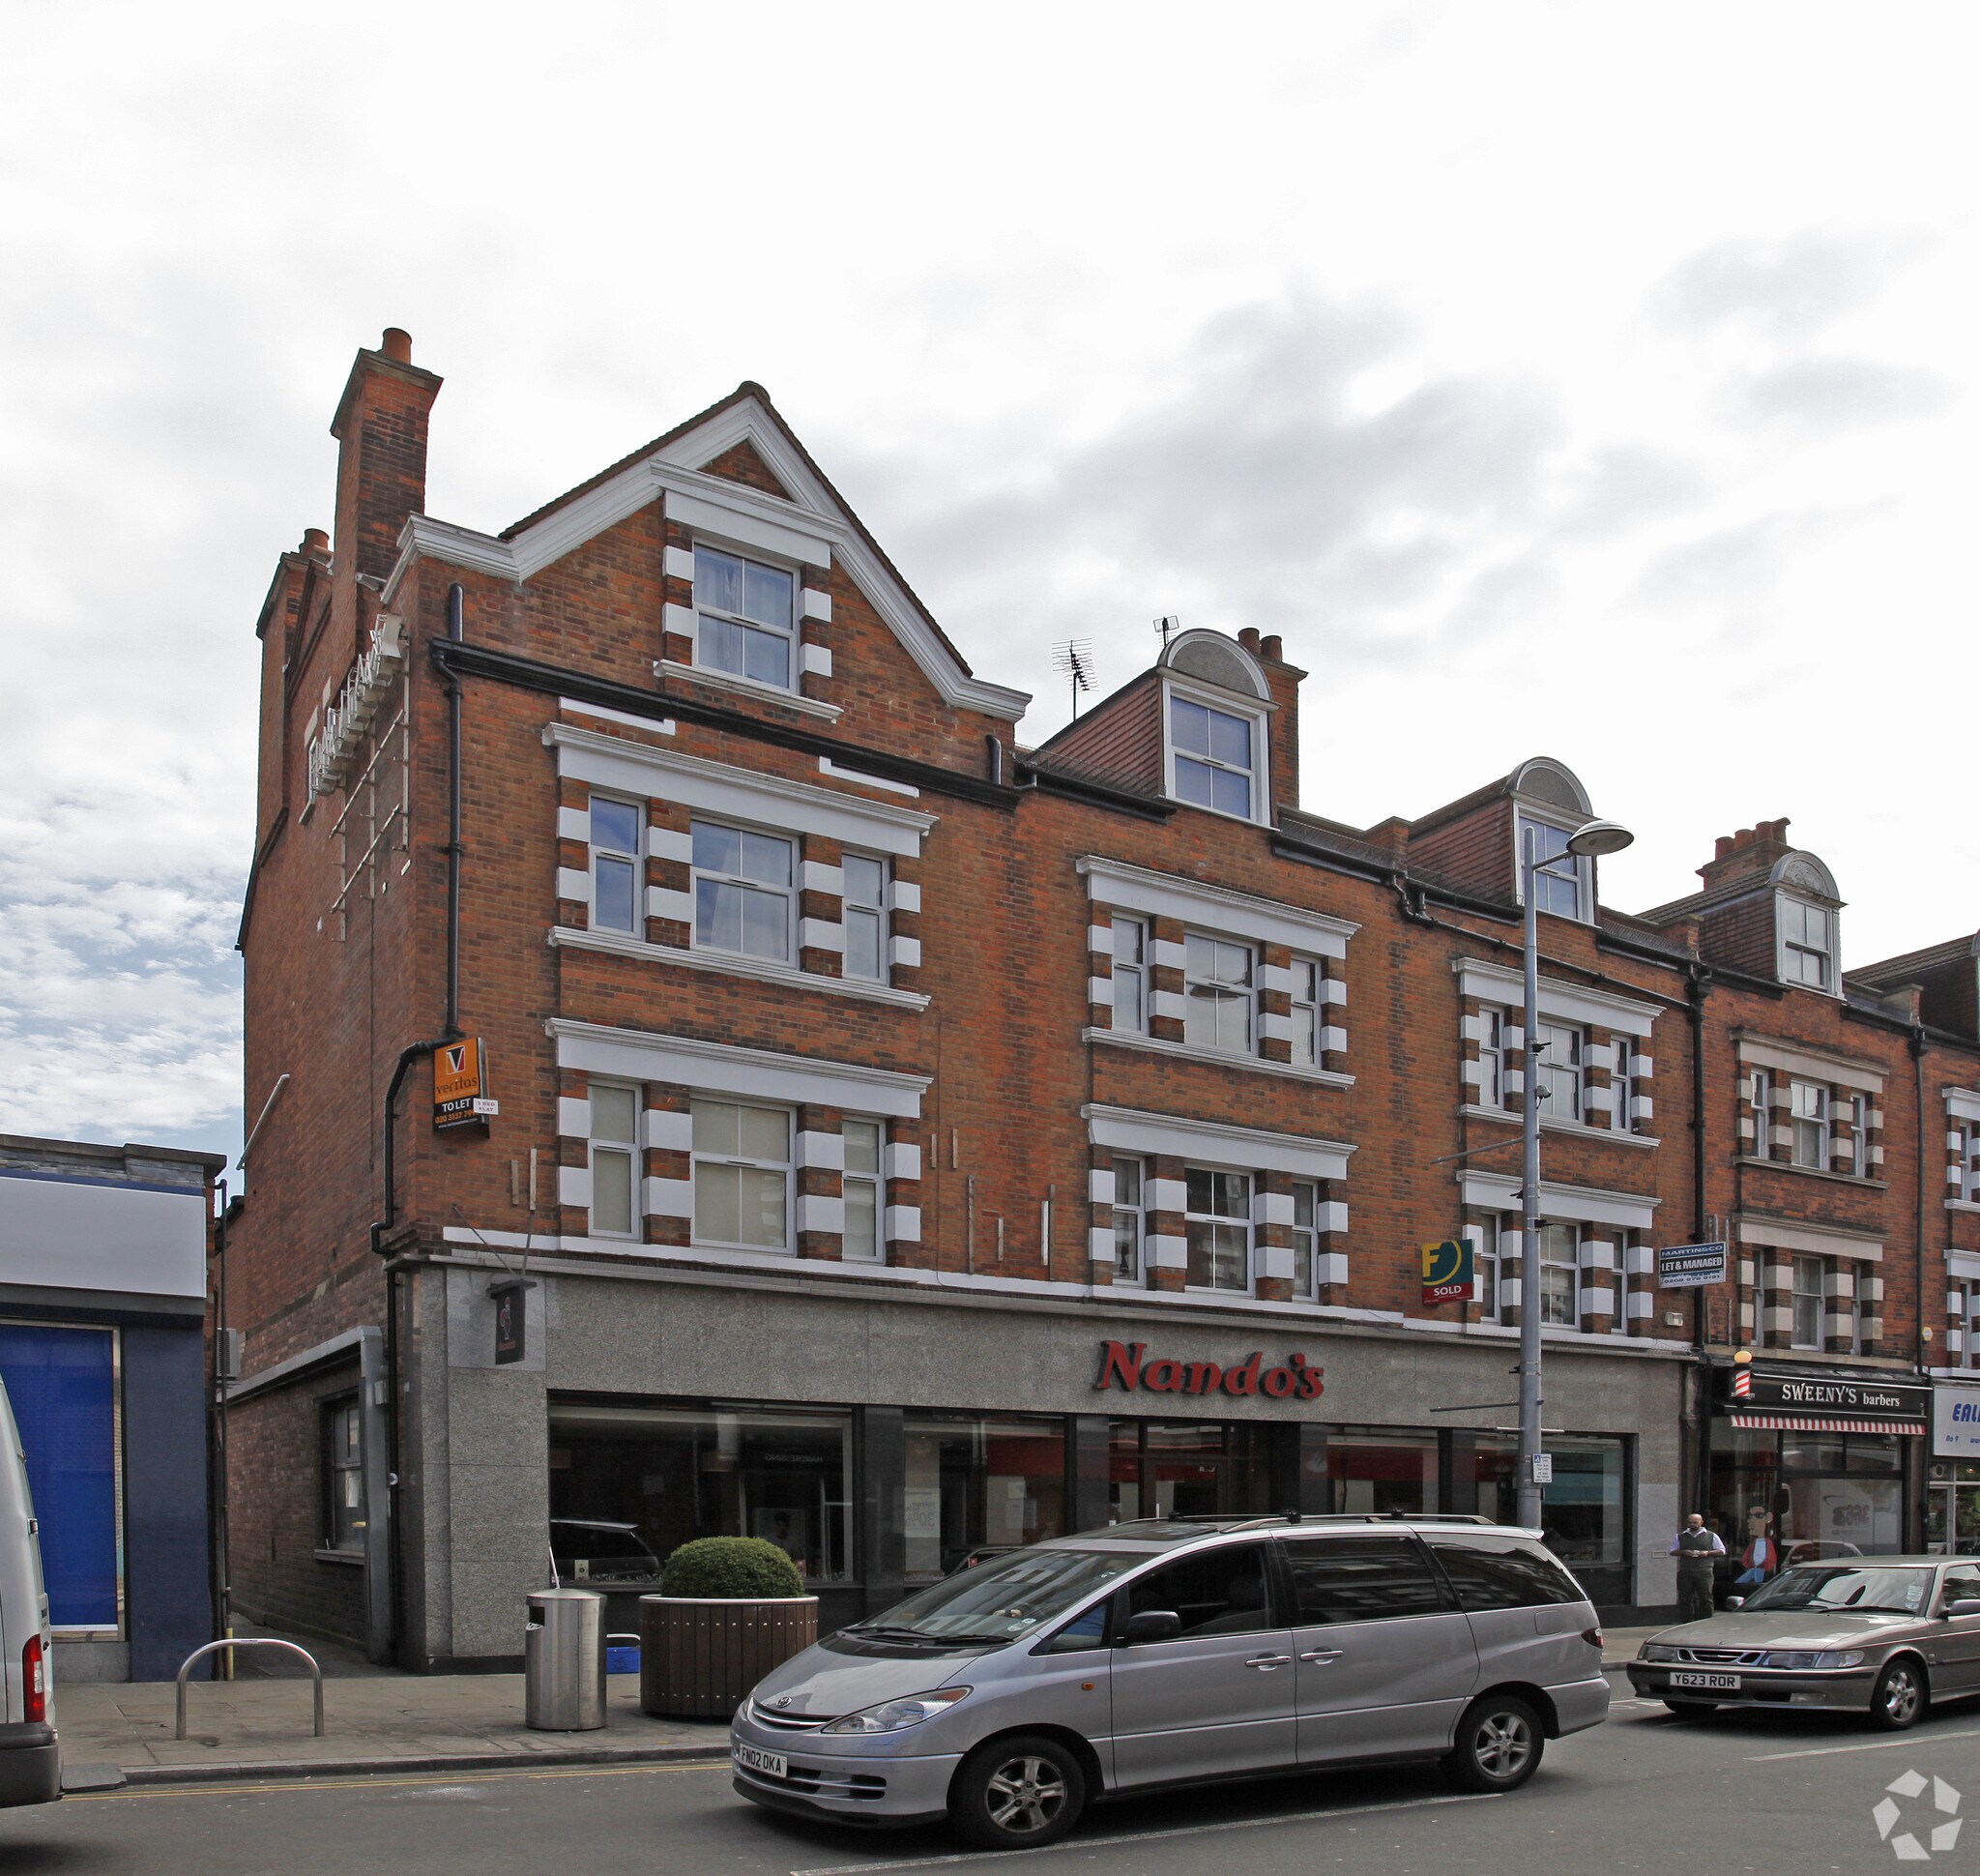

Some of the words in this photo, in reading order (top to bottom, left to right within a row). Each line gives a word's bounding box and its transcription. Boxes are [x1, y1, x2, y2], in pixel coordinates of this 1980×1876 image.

[436, 1076, 478, 1094] veritas
[442, 1102, 454, 1112] TO
[455, 1098, 471, 1110] LET
[1661, 1261, 1674, 1272] LET
[1674, 1261, 1682, 1270] &
[1682, 1257, 1723, 1269] MANAGED
[1434, 1285, 1462, 1296] SOLD
[1095, 1339, 1325, 1399] Nando's
[1782, 1383, 1857, 1403] SWEENY'S
[1863, 1392, 1900, 1407] barbers
[1952, 1403, 1980, 1423] EAL
[1674, 1674, 1705, 1685] Y623
[1709, 1675, 1735, 1687] ROR
[742, 1746, 761, 1767] FN02
[763, 1754, 781, 1773] OKA
